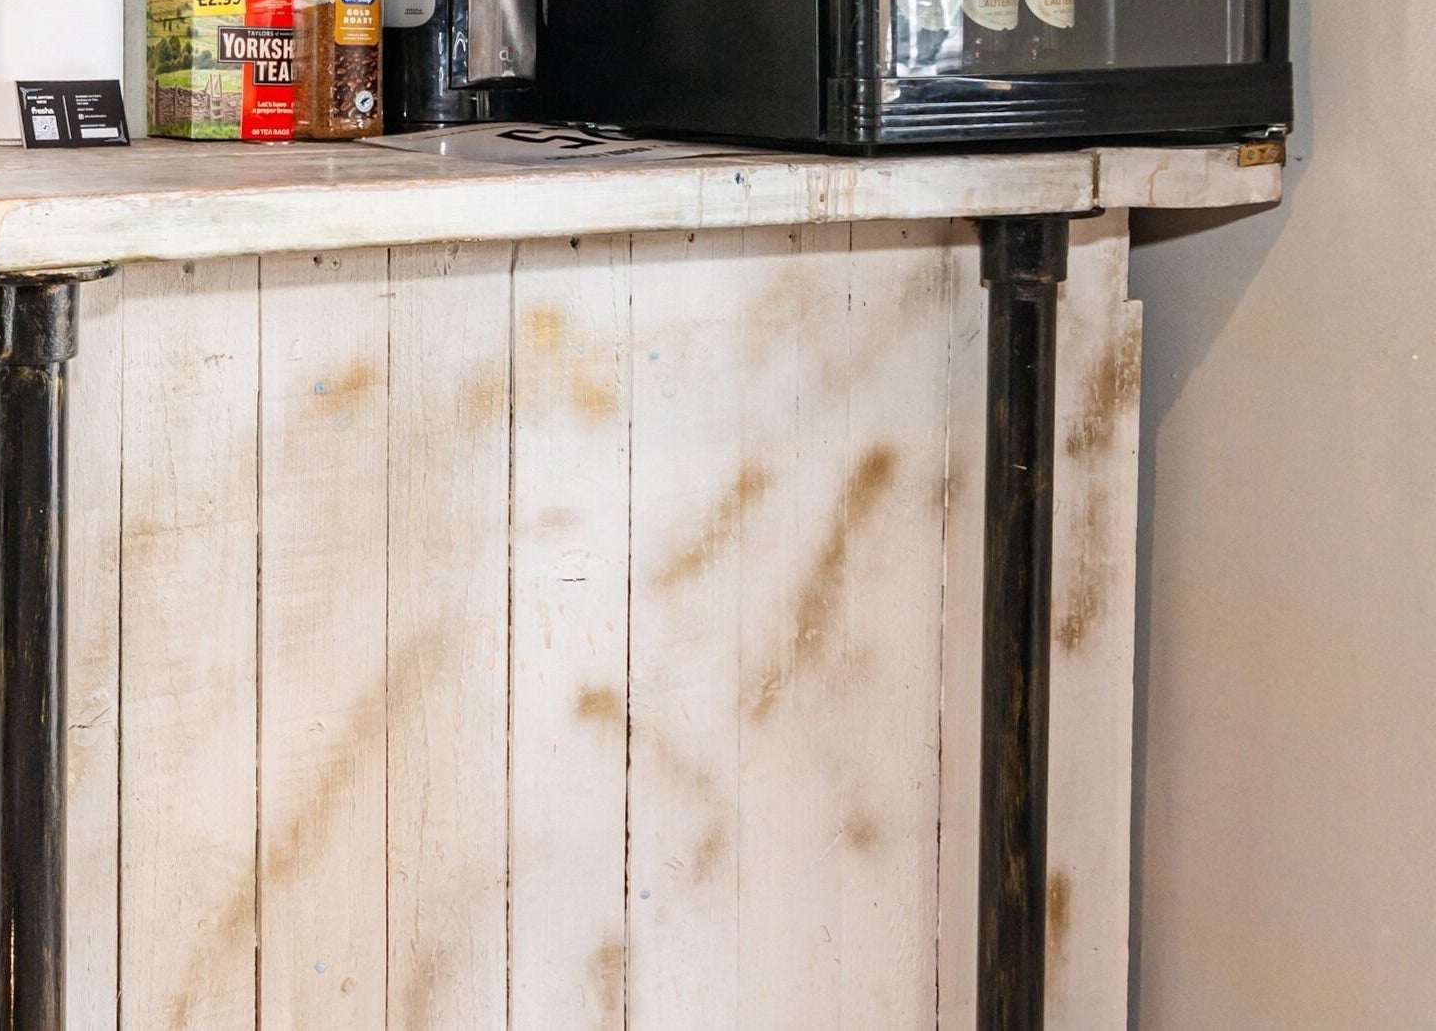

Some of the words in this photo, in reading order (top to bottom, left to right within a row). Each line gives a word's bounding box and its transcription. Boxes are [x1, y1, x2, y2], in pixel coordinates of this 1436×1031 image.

[346, 8, 371, 17] GOLD
[222, 33, 294, 60] YORKSH
[257, 61, 290, 82] TEA
[261, 128, 273, 136] TEA
[273, 128, 290, 136] BAGS
